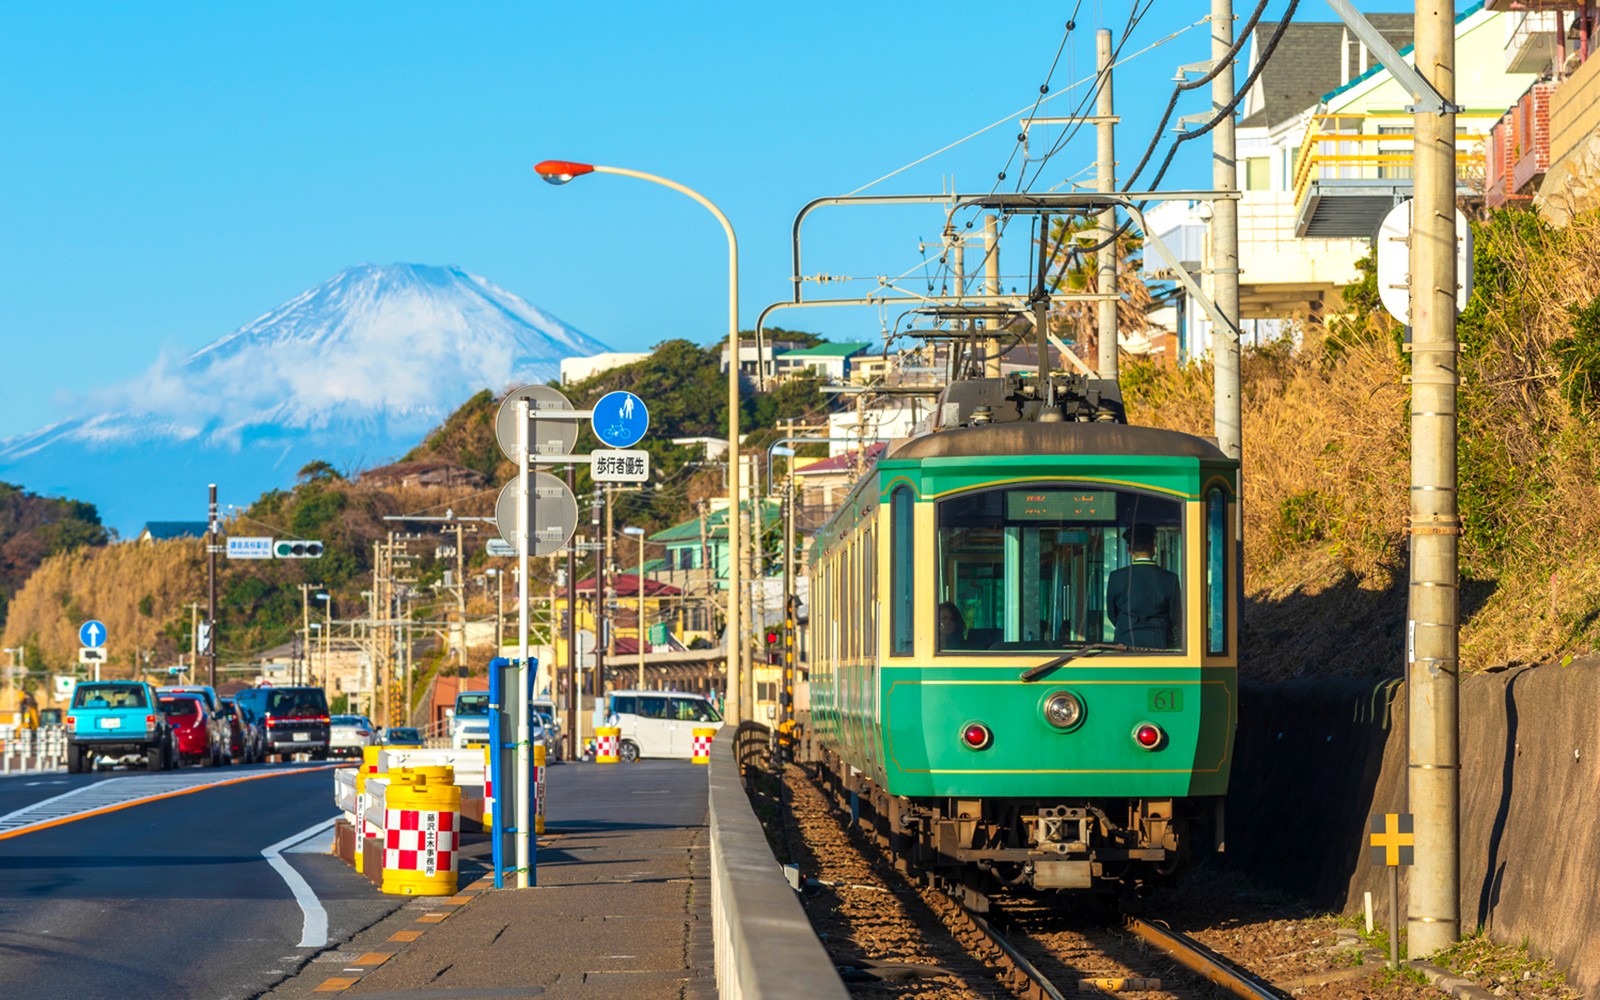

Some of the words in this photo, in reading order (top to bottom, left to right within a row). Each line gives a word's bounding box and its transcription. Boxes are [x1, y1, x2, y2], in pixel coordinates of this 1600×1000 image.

[597, 456, 644, 475] 歩行者優先
[1153, 690, 1176, 710] 61
[426, 813, 436, 875] 藤沢土木事務所
